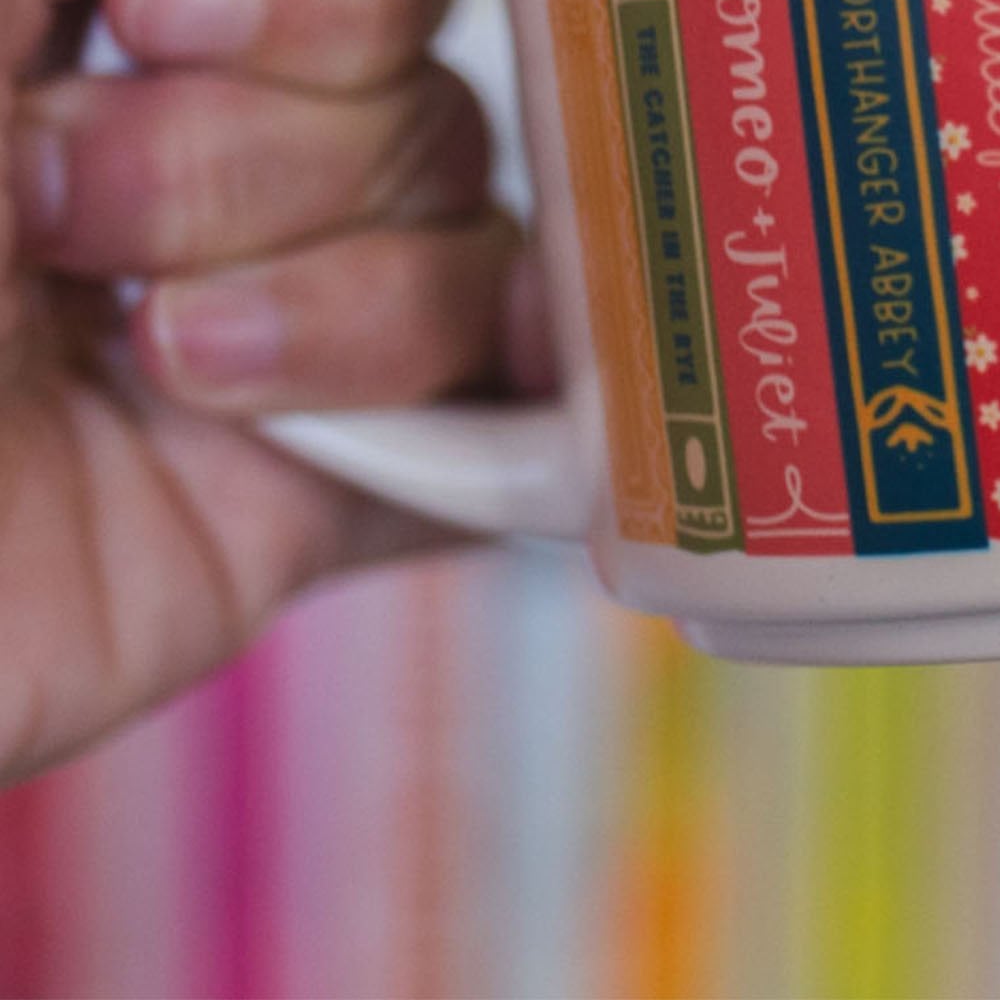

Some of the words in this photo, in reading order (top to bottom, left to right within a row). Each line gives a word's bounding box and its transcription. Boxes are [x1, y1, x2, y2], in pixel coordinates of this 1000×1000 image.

[636, 26, 660, 77] THE
[643, 87, 676, 220] CATCHER
[661, 231, 681, 260] IN
[666, 273, 688, 321] THE
[869, 244, 919, 377] ABBEY
[674, 333, 697, 386] RYE
[724, 231, 808, 446] Juliet
